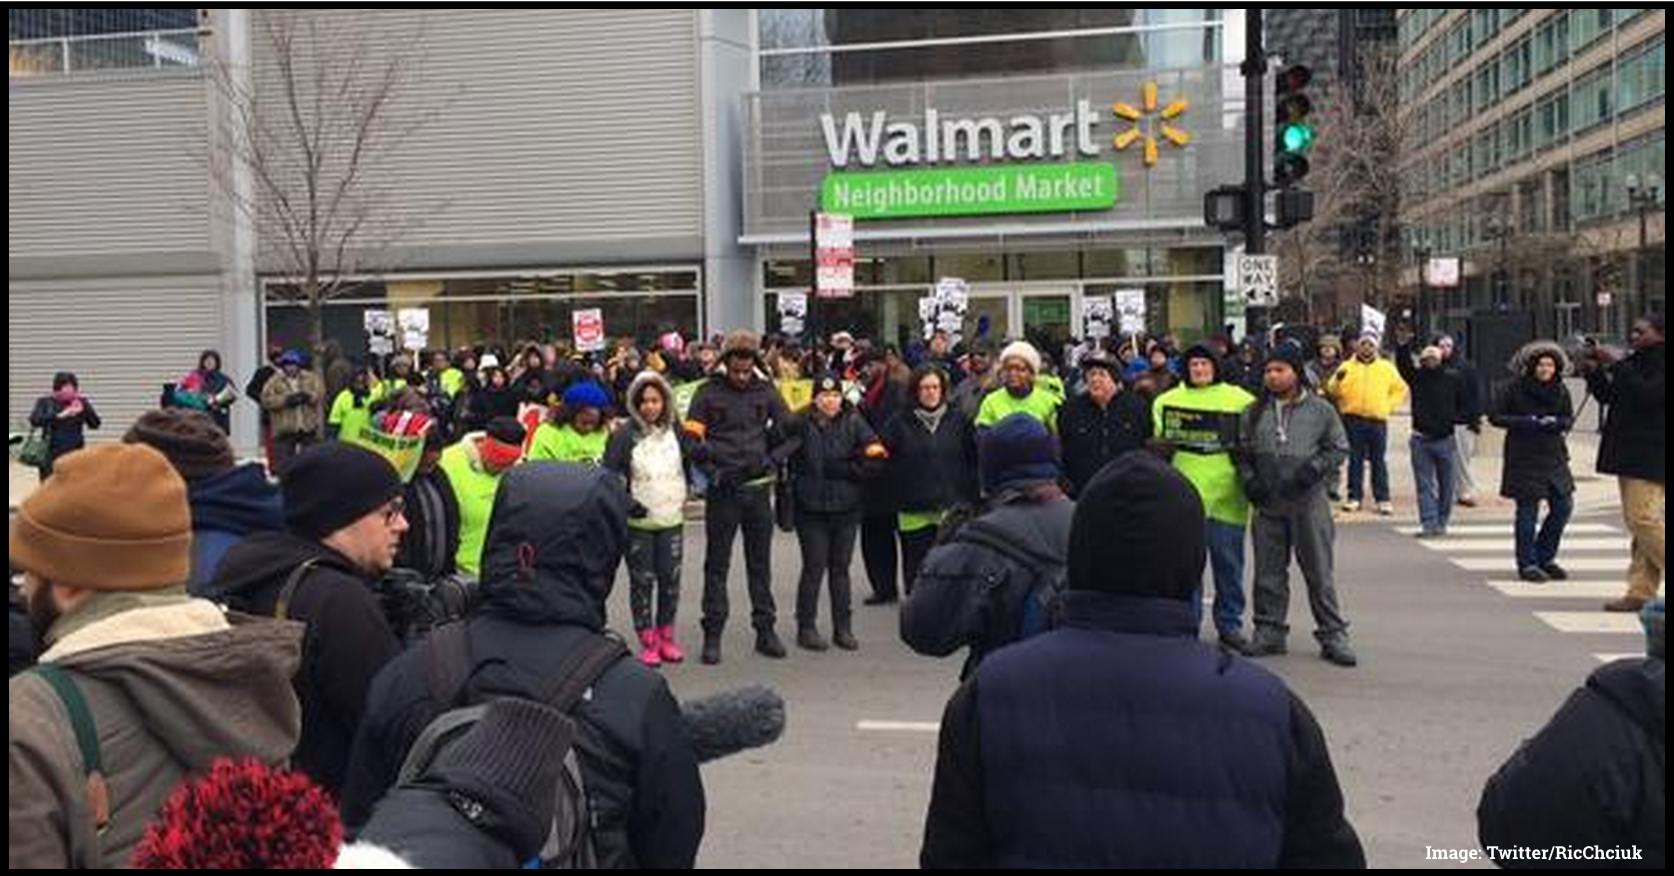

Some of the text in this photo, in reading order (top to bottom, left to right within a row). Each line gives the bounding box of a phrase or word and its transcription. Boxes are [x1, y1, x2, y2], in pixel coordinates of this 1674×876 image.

[820, 99, 1101, 167] Walmart
[834, 173, 1105, 214] Neighborhood Market
[1242, 258, 1273, 272] ONE
[1243, 272, 1273, 285] WAY
